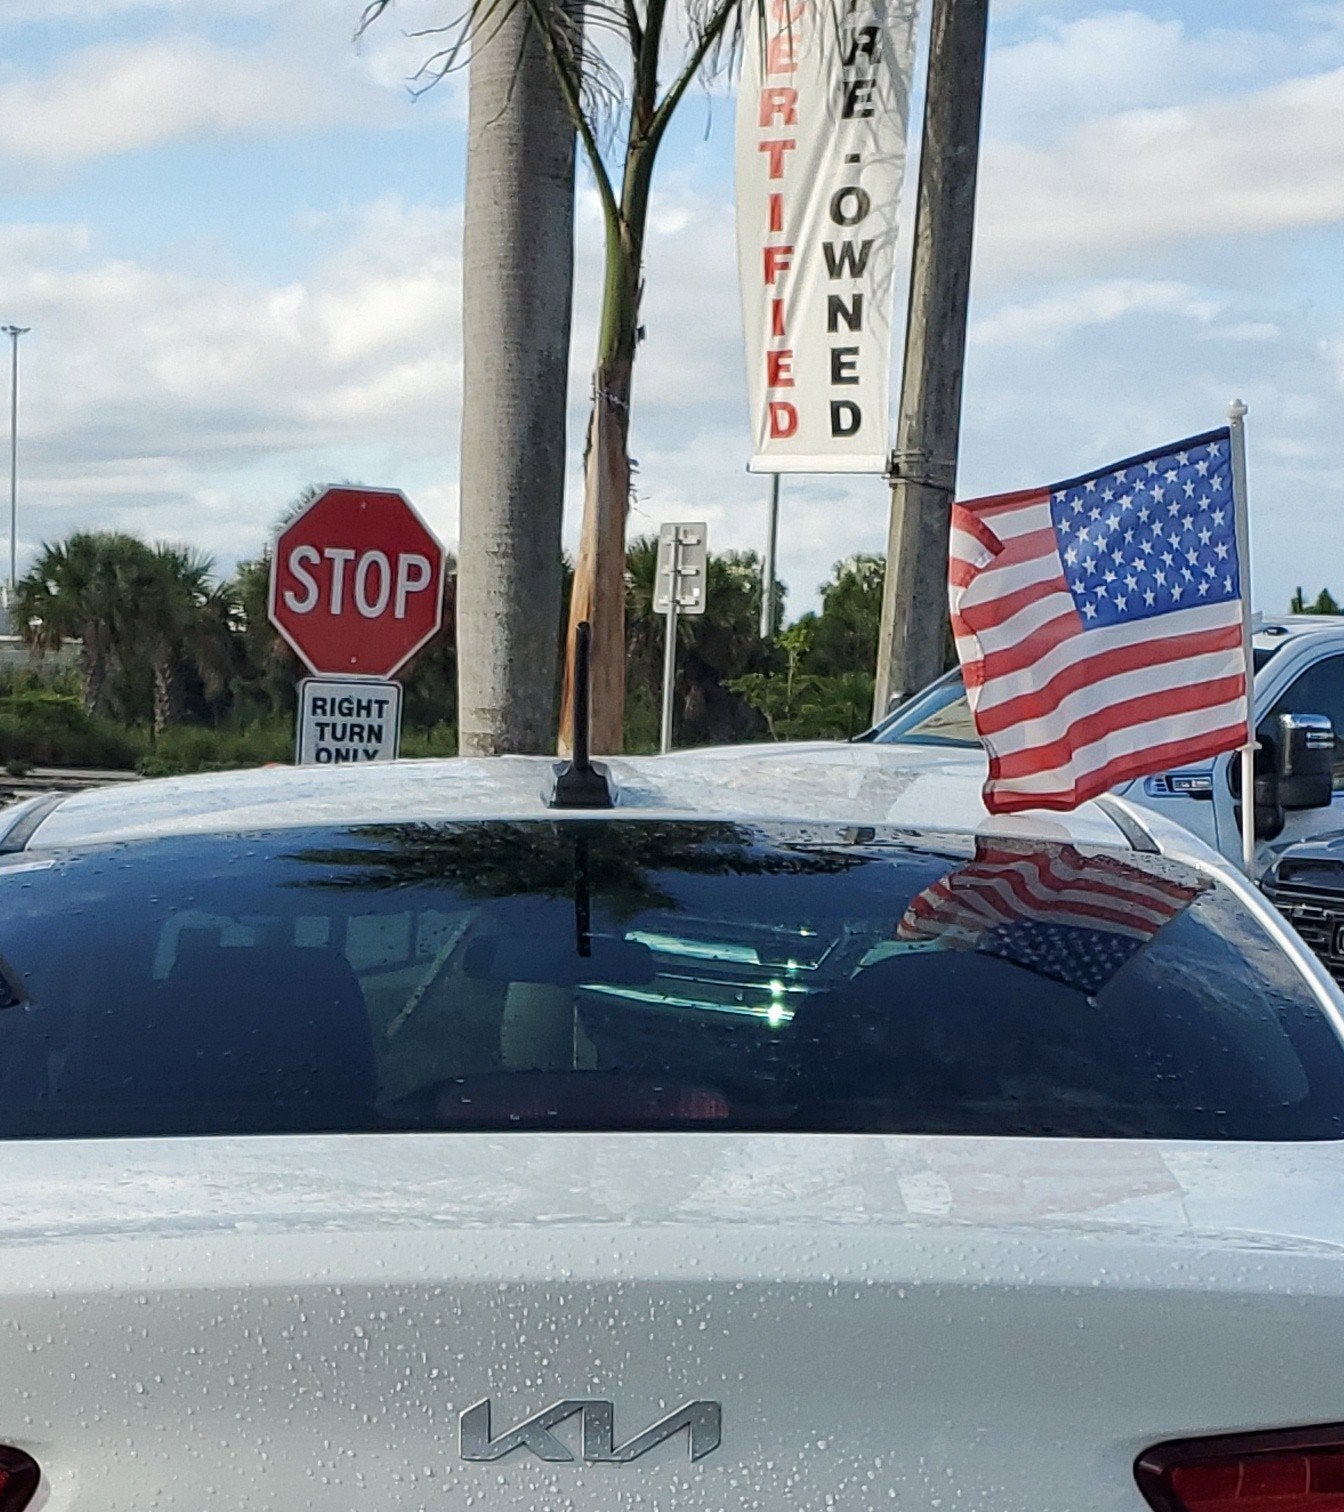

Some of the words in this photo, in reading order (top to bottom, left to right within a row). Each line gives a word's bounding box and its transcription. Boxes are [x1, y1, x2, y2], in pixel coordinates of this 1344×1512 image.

[284, 545, 432, 619] STOP
[311, 697, 390, 719] RIGHT
[314, 722, 384, 744] TURN
[459, 1398, 722, 1463] KIA
